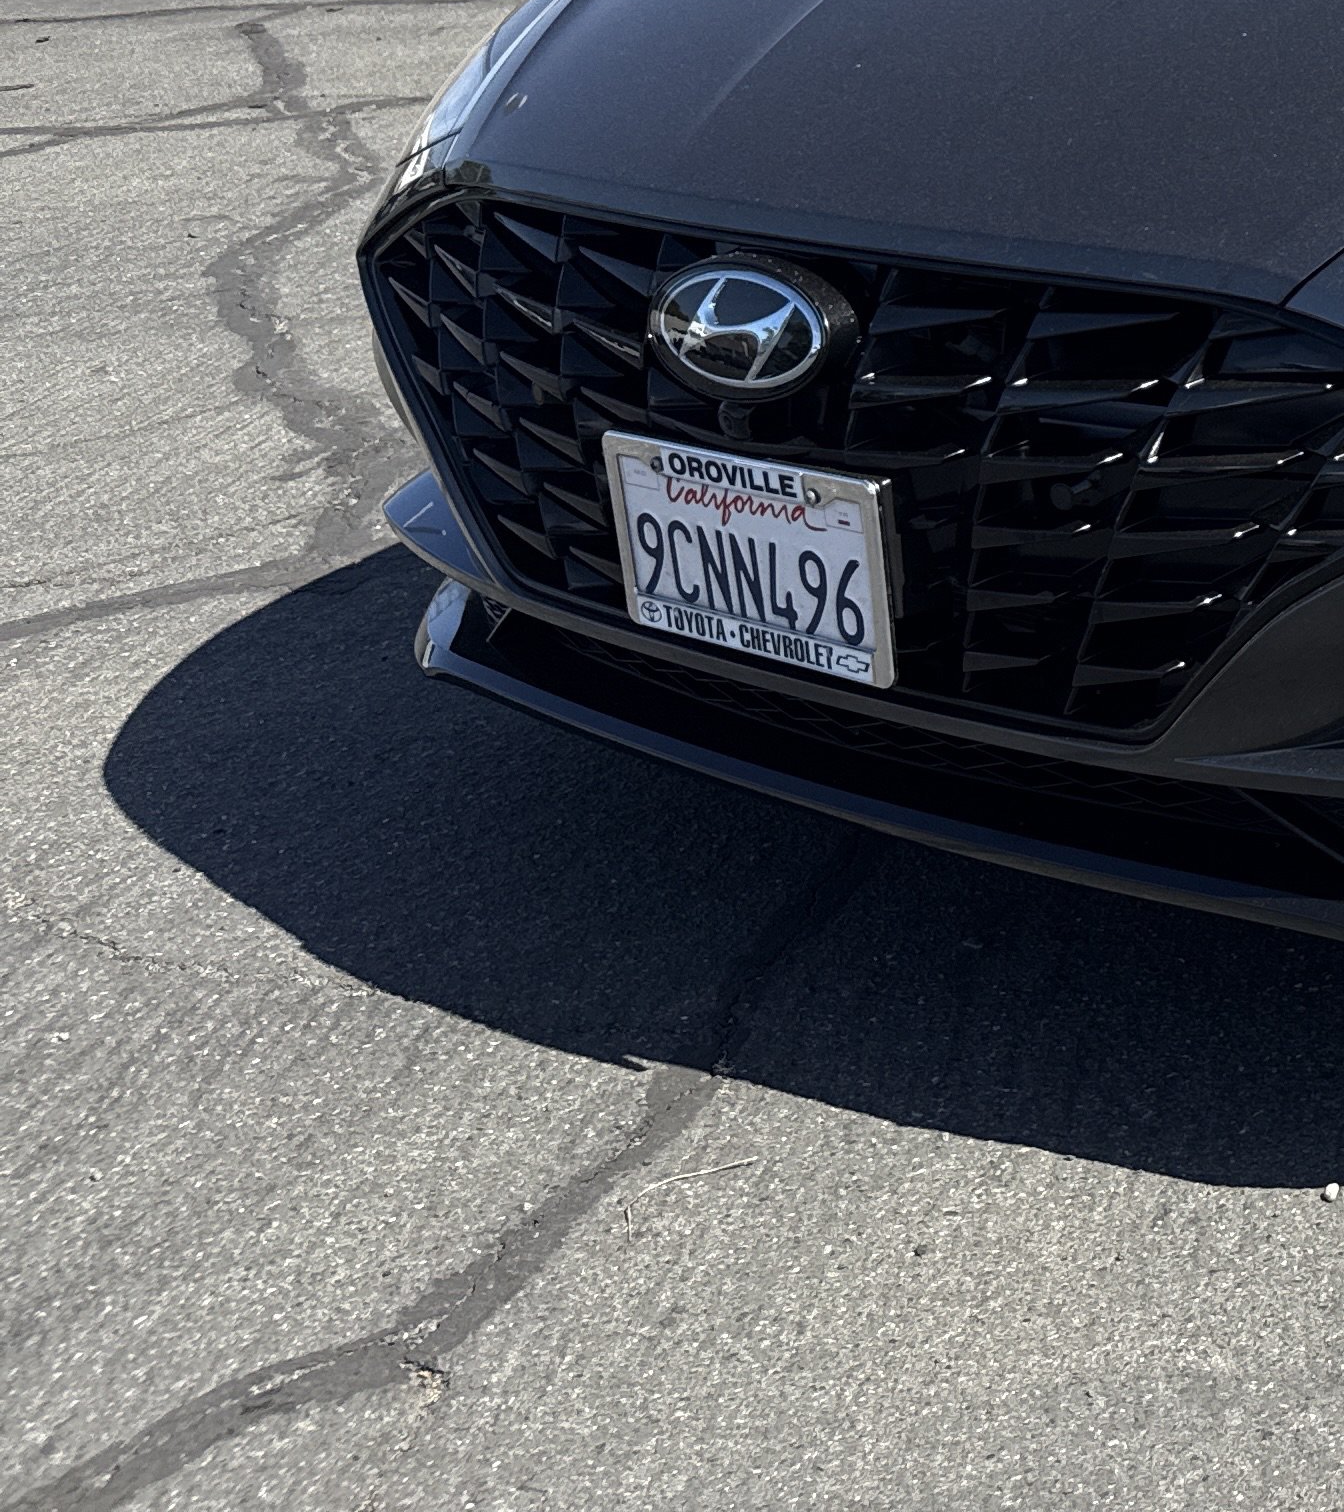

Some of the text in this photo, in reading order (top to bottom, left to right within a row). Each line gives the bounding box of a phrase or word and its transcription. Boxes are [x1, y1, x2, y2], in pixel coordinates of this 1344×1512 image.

[666, 477, 828, 532] California
[668, 452, 798, 499] OROVILLE
[636, 512, 866, 647] 9CNN496
[662, 604, 834, 671] TOYOTA CHEVROLET
